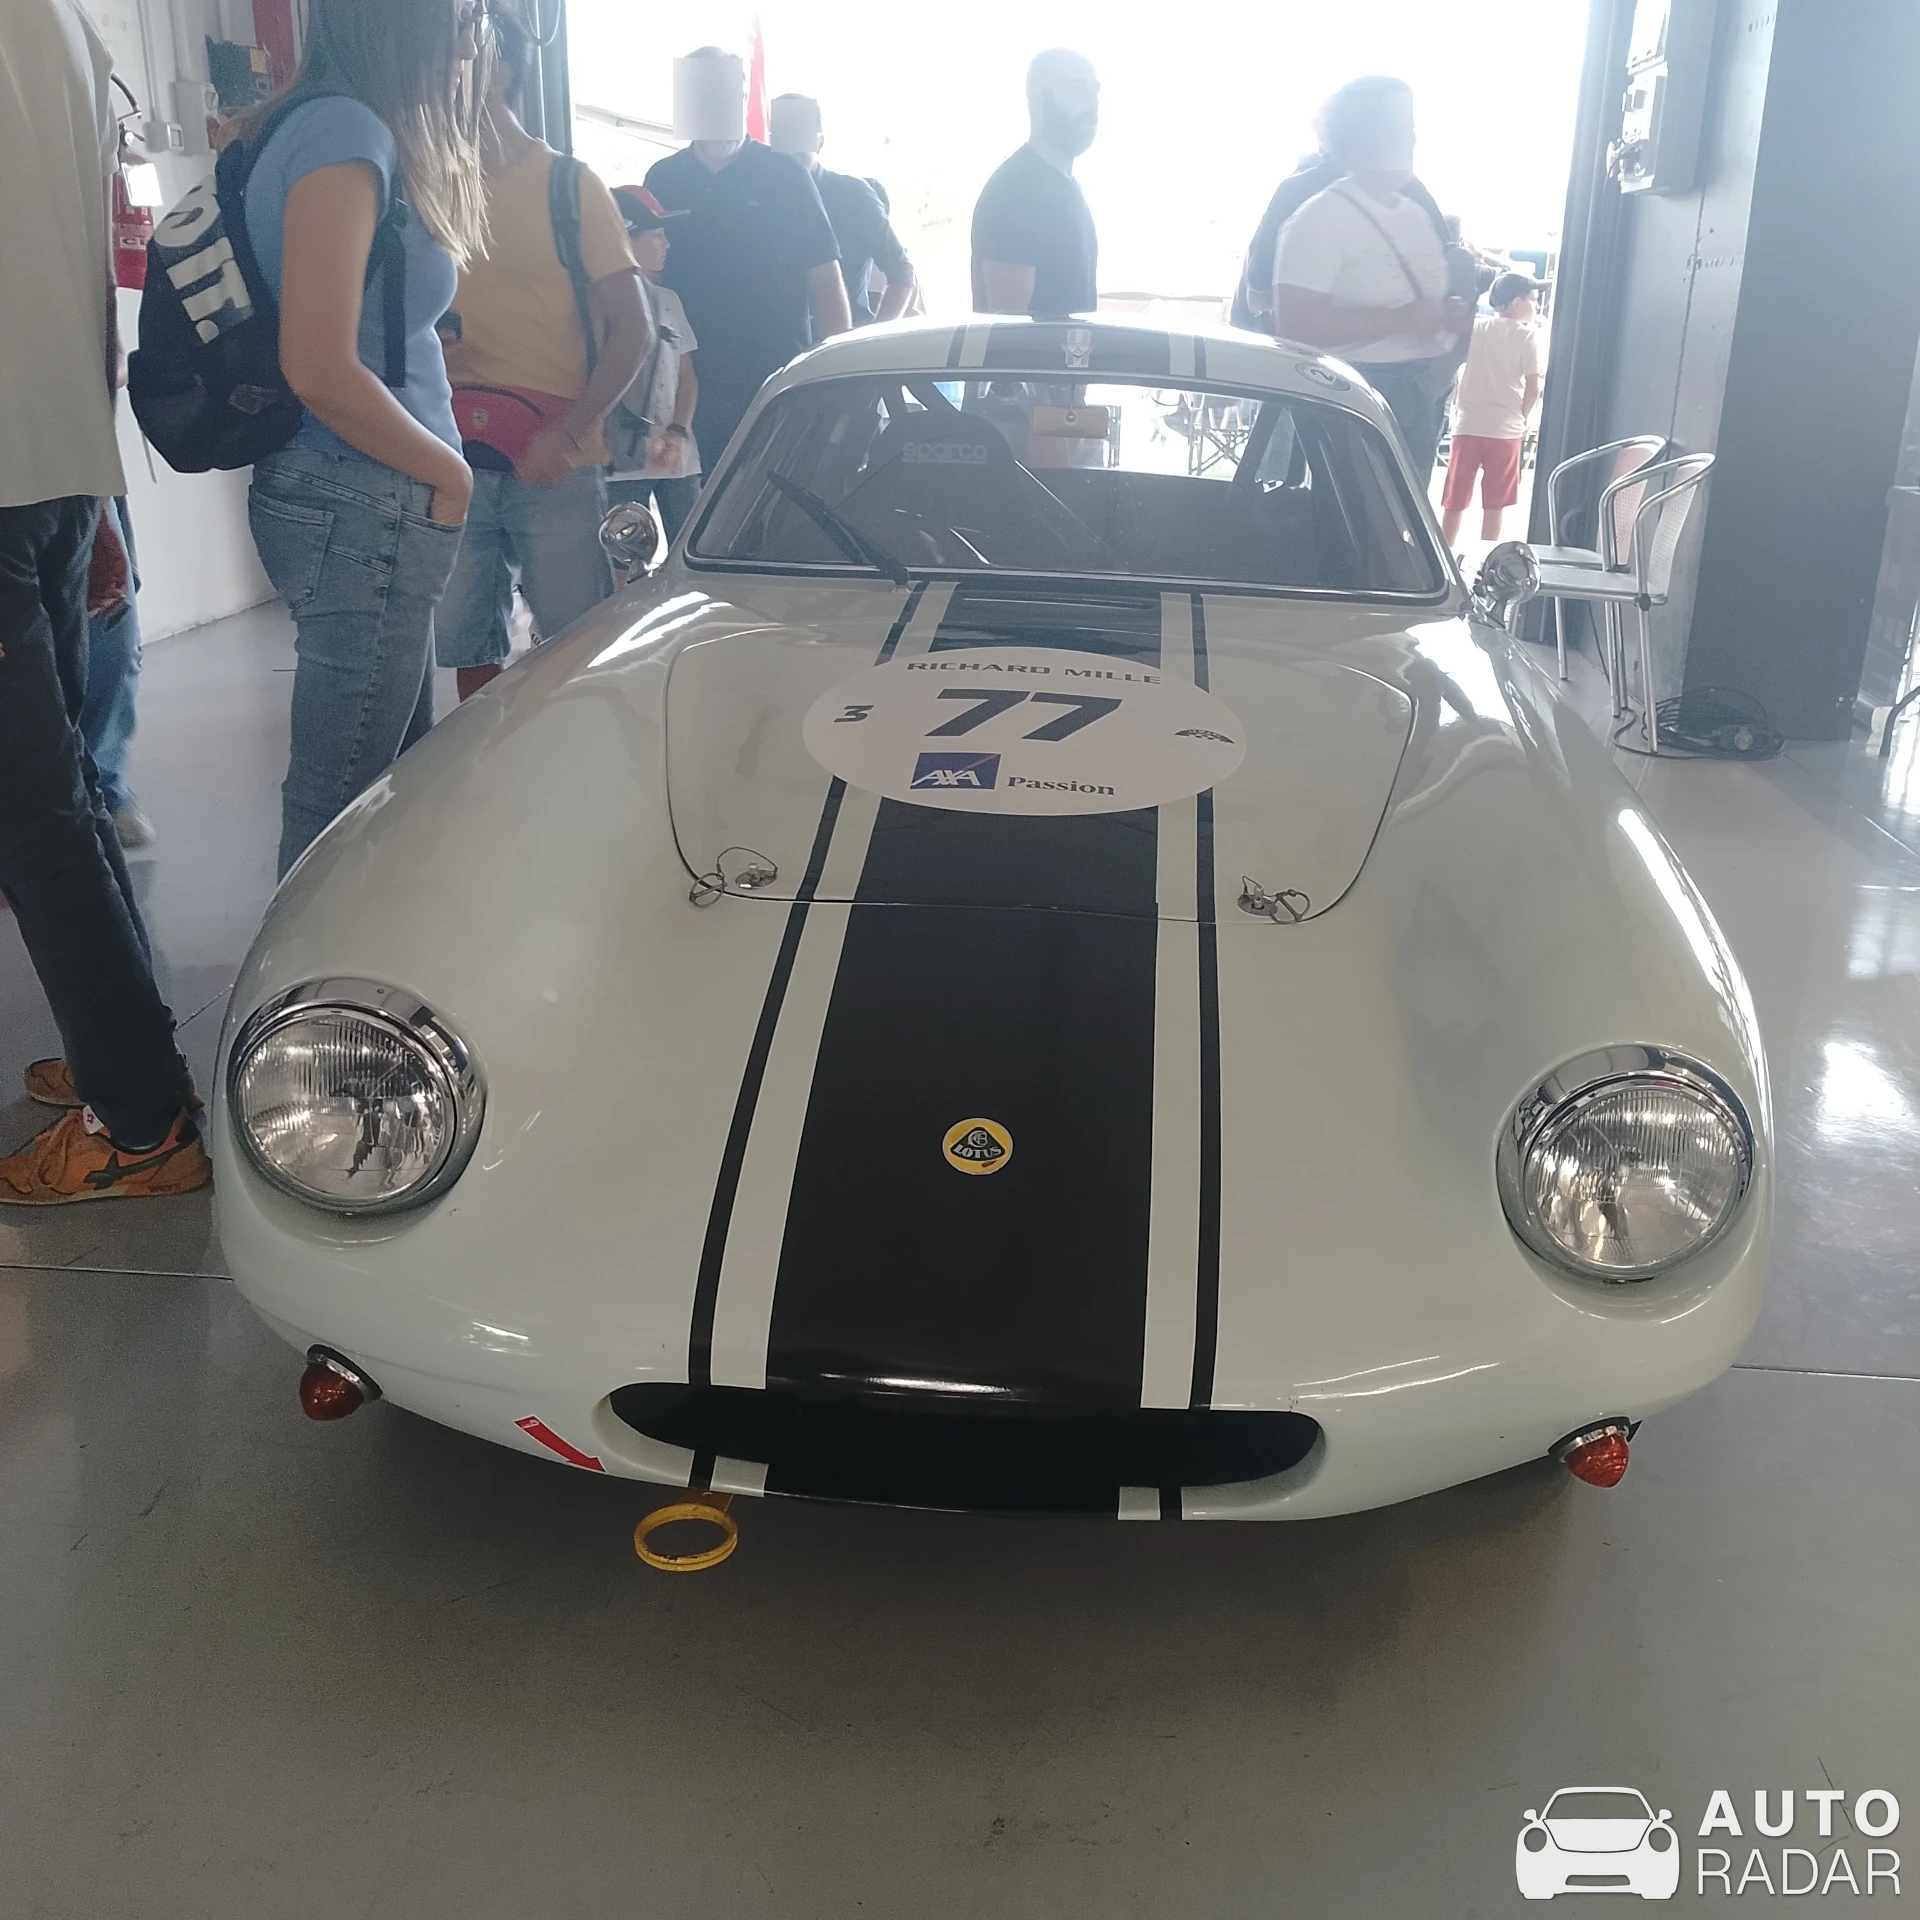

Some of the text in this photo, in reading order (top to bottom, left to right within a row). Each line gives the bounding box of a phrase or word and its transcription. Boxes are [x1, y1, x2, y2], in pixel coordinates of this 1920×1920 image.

[902, 442, 987, 463] sparco
[907, 662, 1161, 685] RICHARD MILLE
[833, 704, 875, 723] 3
[924, 688, 1123, 742] 77
[911, 769, 1116, 796] AXA Passion
[953, 1143, 1002, 1159] LOTUS
